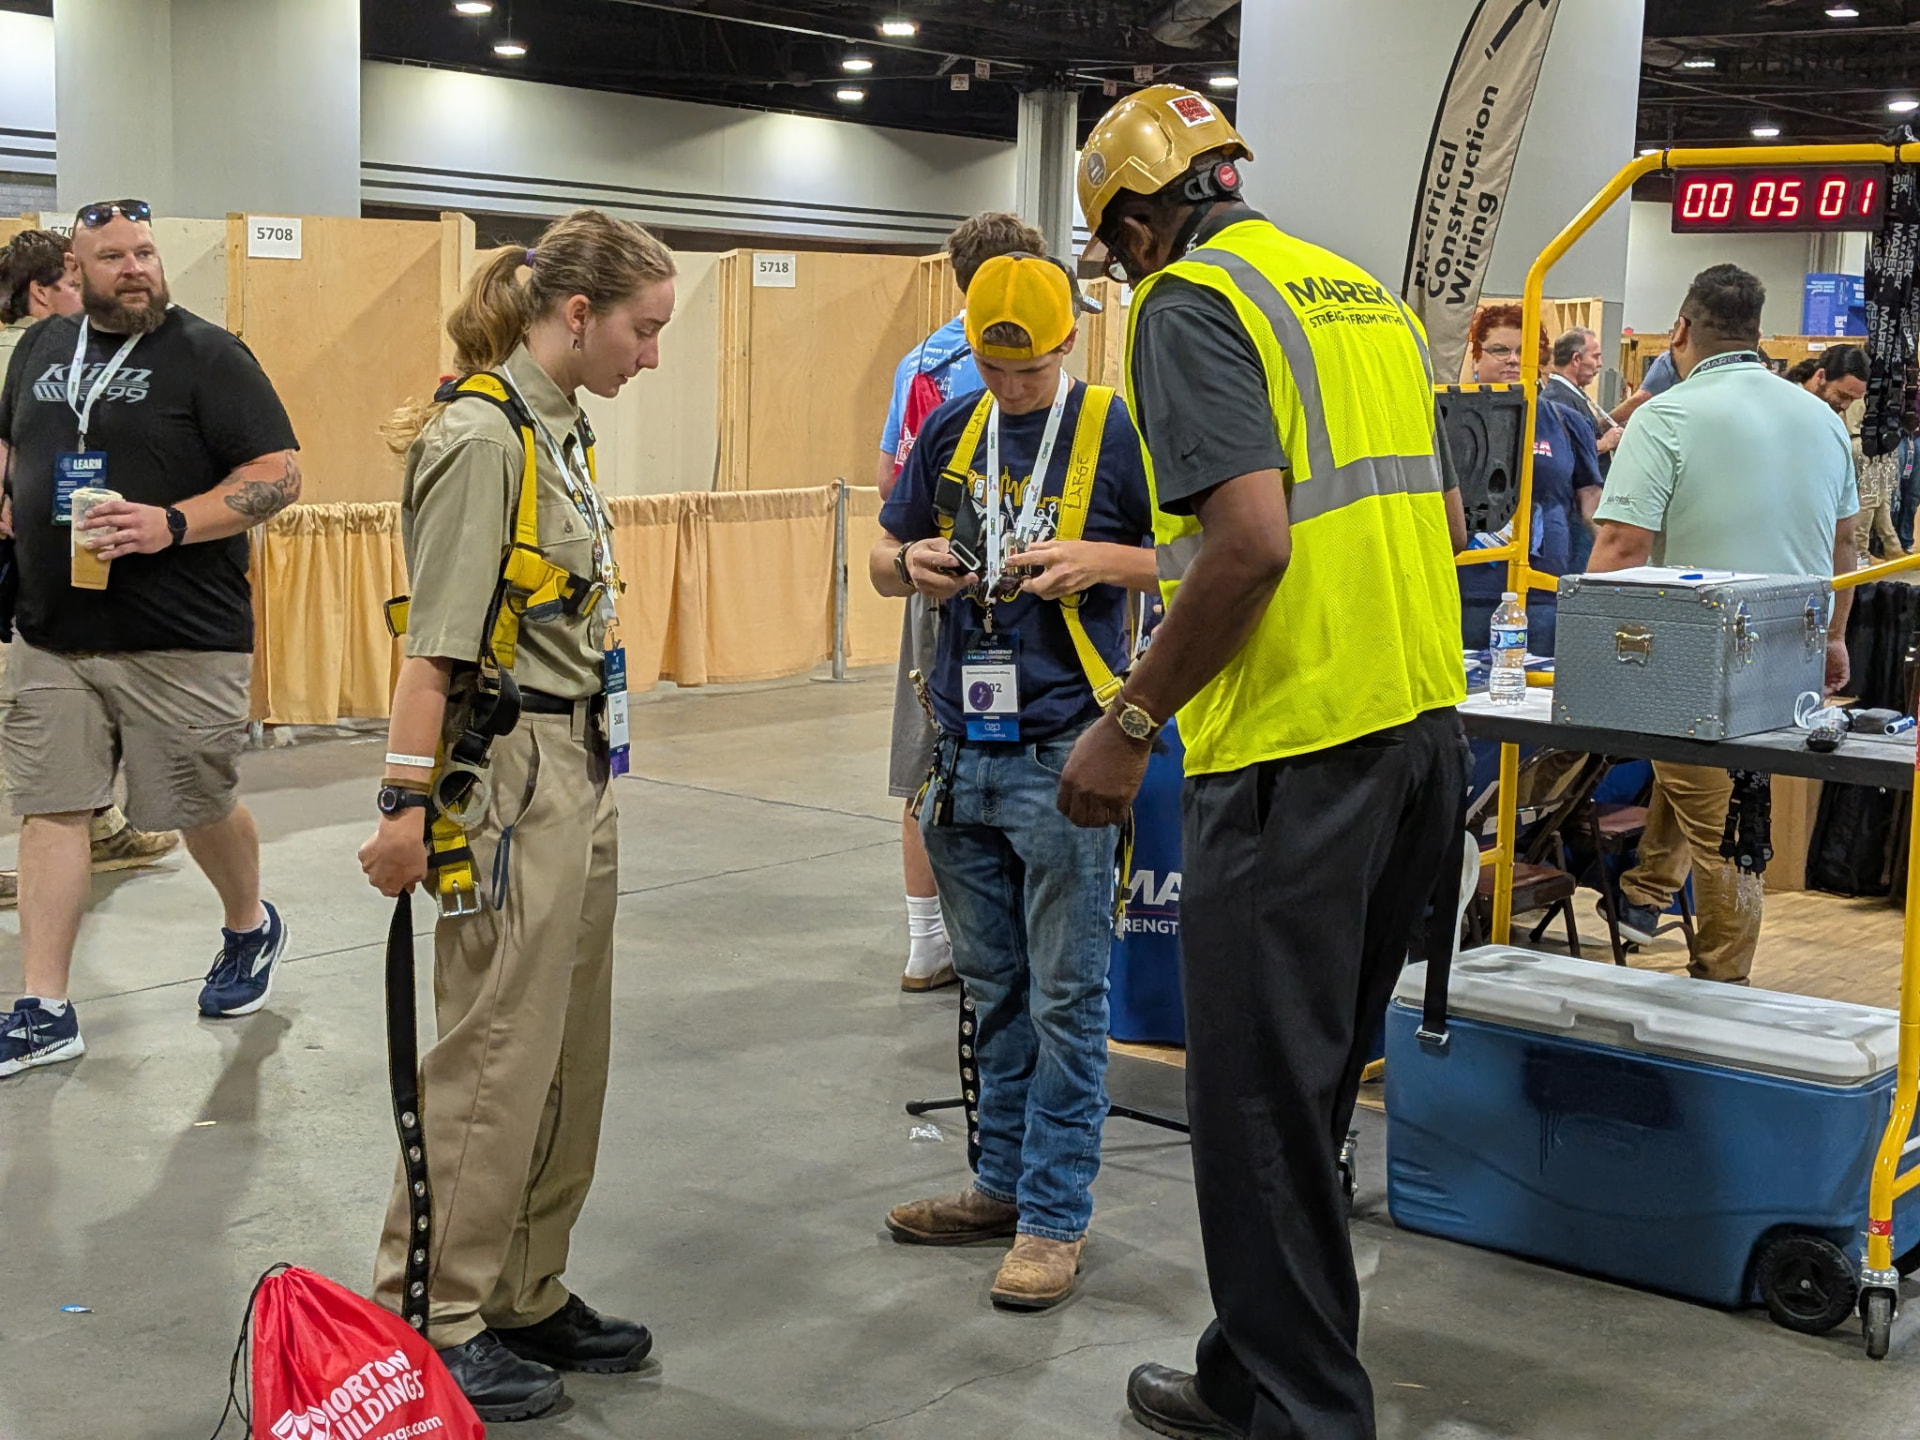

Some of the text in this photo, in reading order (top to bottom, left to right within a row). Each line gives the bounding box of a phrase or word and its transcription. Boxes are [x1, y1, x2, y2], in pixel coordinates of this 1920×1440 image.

[1428, 85, 1499, 298] Construction
[1682, 182, 1734, 218] 00
[1749, 181, 1802, 217] 05
[1819, 180, 1874, 216] 01
[256, 226, 294, 242] 5708
[1445, 191, 1499, 305] Wiring
[1886, 222, 1903, 278] MAREK
[759, 261, 790, 273] 5718
[1284, 276, 1398, 309] MAREK
[1351, 313, 1378, 326] FROM
[1875, 305, 1890, 361] MAREK
[1063, 454, 1090, 510] LARGE
